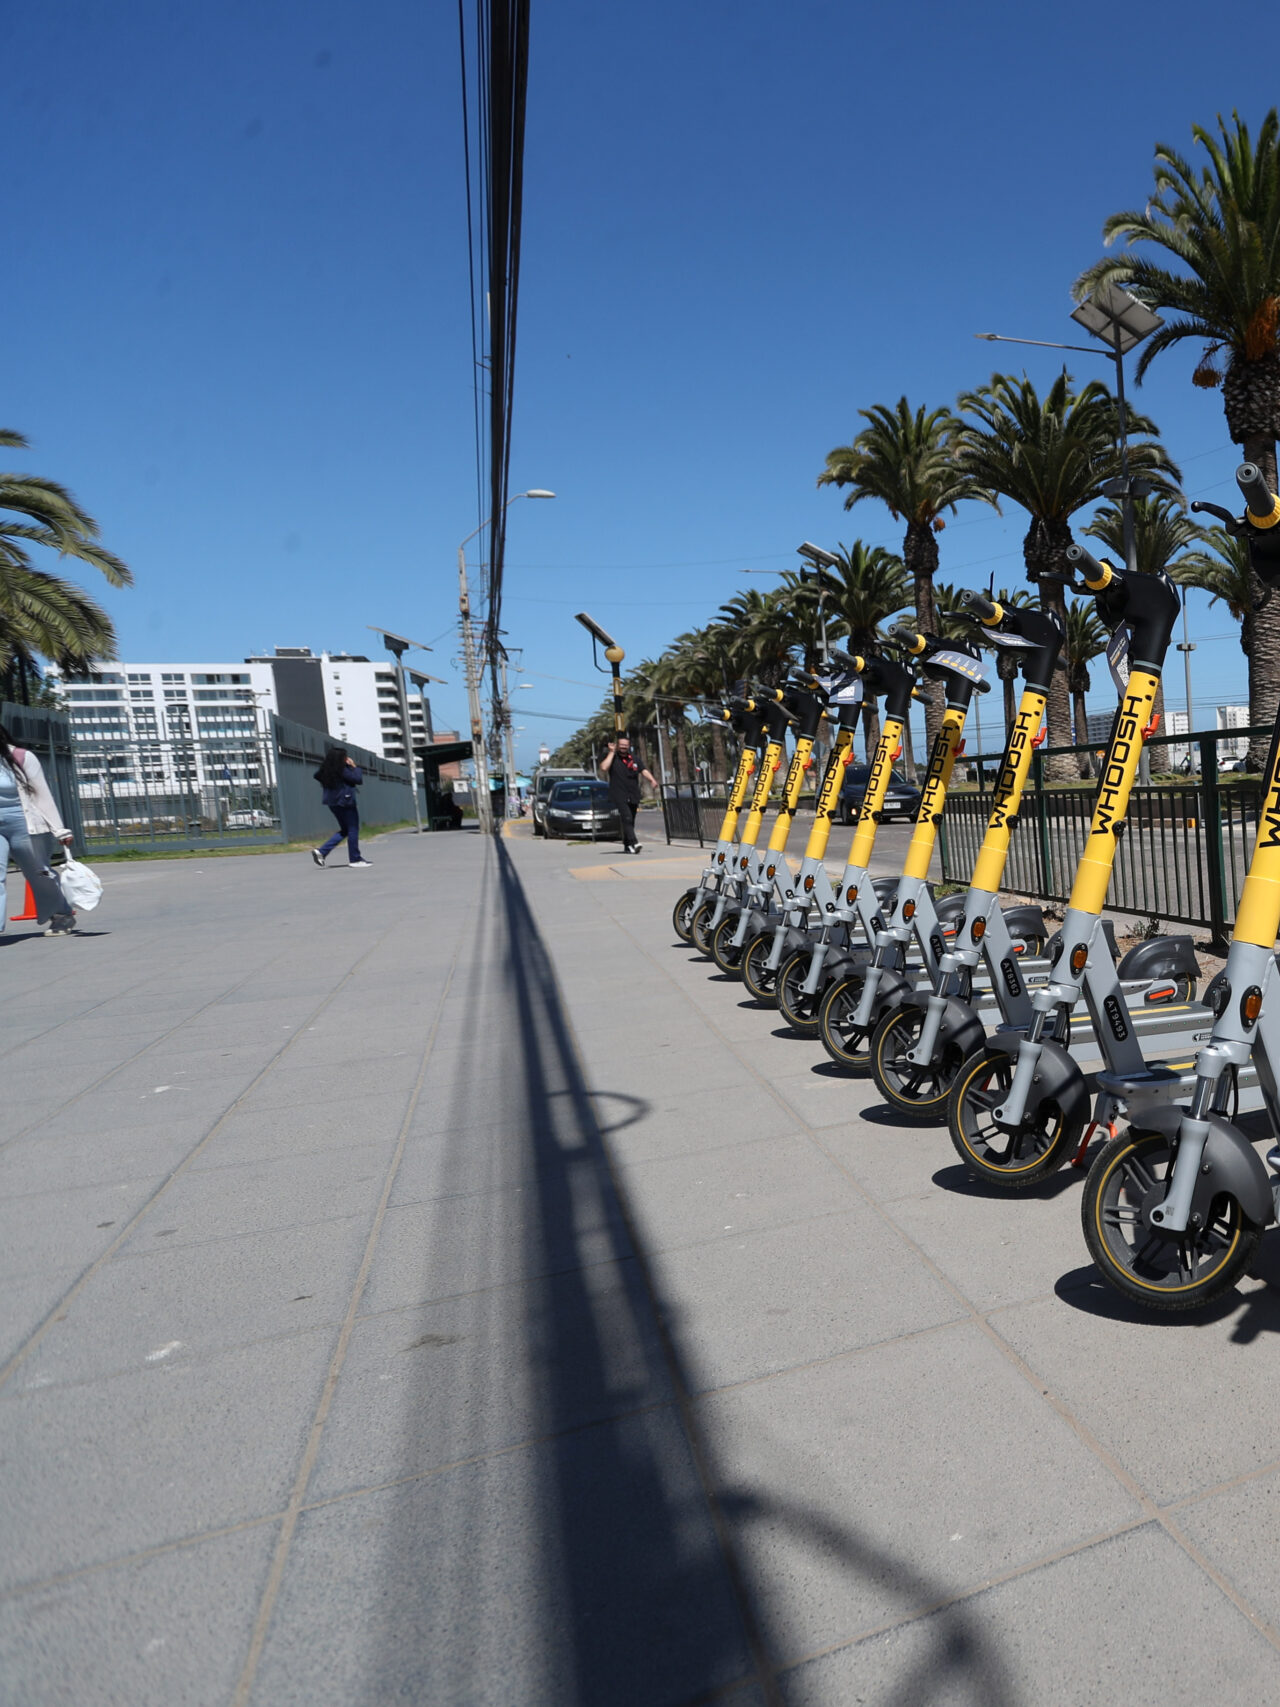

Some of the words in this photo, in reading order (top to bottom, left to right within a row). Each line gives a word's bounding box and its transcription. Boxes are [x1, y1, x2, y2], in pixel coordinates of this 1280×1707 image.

[728, 758, 747, 812] WHOOSH
[751, 753, 773, 812] WHOOSH
[779, 750, 804, 815] WHOOSH
[816, 743, 844, 819] WHOOSH
[860, 735, 891, 821] WHOOSH
[918, 726, 953, 824] WHOOSH
[989, 711, 1032, 829] WHOOSH
[1092, 695, 1143, 835] WHOOSH
[1002, 962, 1019, 995] AT8362
[1107, 1000, 1126, 1038] AT9493
